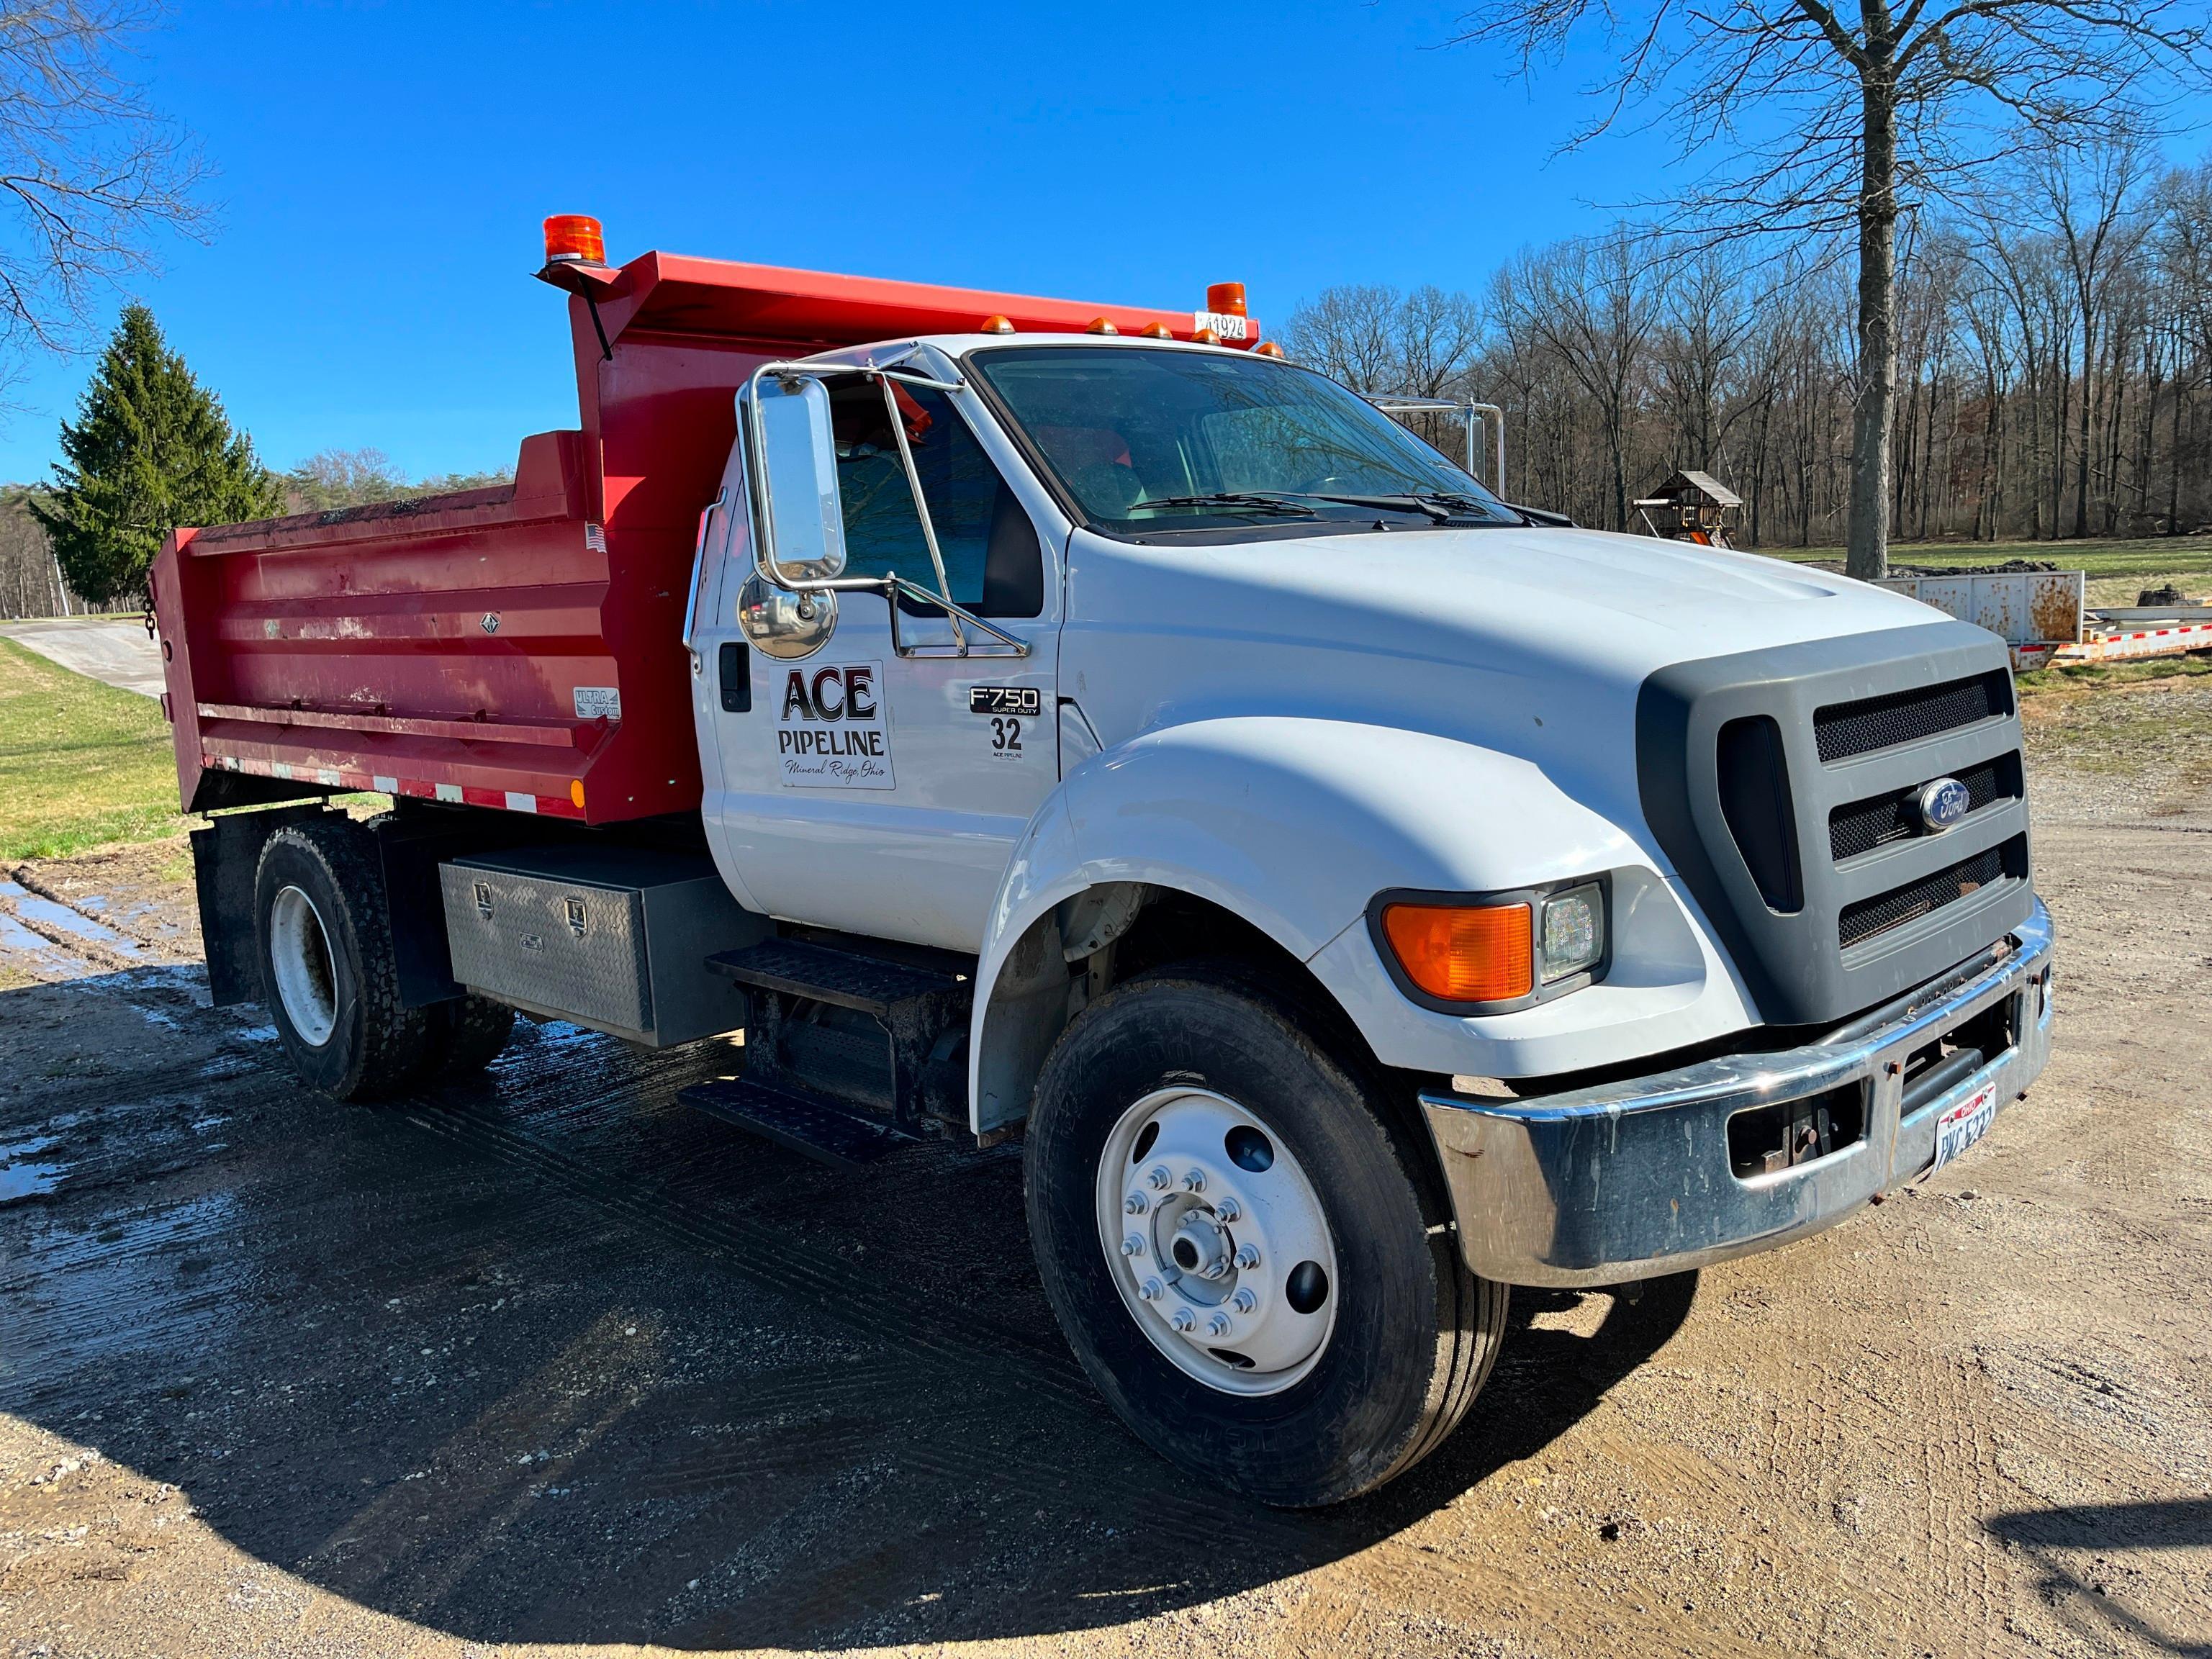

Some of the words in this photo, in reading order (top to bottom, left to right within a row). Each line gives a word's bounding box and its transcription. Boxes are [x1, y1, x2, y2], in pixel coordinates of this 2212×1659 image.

[576, 690, 609, 704] ULTRA
[781, 666, 877, 723] ACE
[591, 705, 619, 716] Custom
[778, 731, 885, 756] PIPELINE
[990, 718, 1022, 750] 32
[785, 759, 828, 776] Mineral
[860, 760, 885, 778] Ohio
[1940, 790, 1964, 819] Ford
[1961, 1100, 1976, 1117] OHIO
